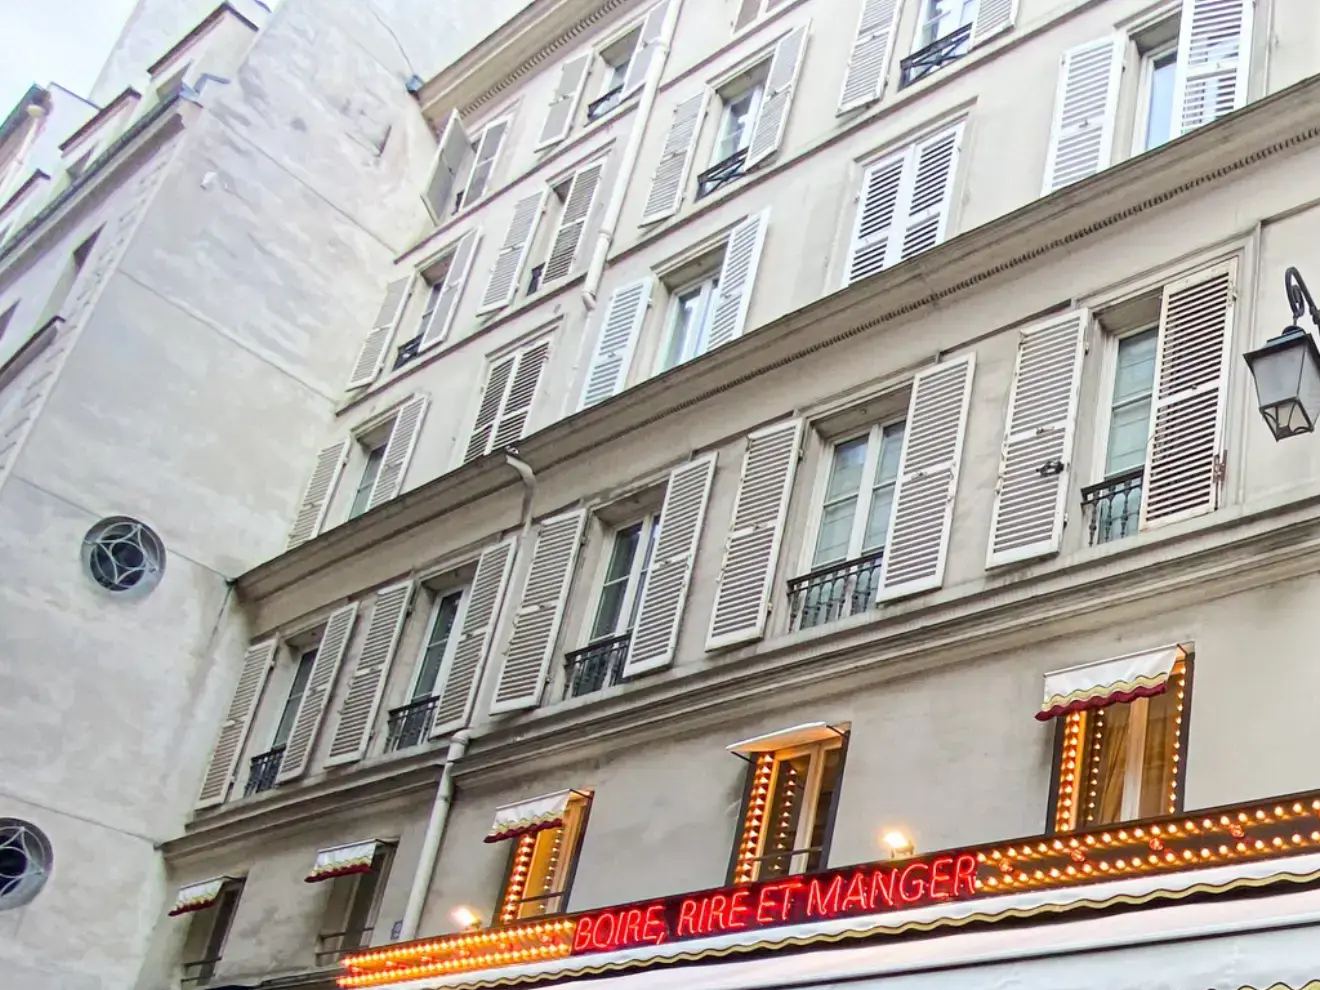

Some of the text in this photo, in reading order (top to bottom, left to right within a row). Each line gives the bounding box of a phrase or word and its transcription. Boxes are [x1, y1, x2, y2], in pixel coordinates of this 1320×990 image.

[573, 854, 978, 952] BOIRE, RIRE ET MANGER
